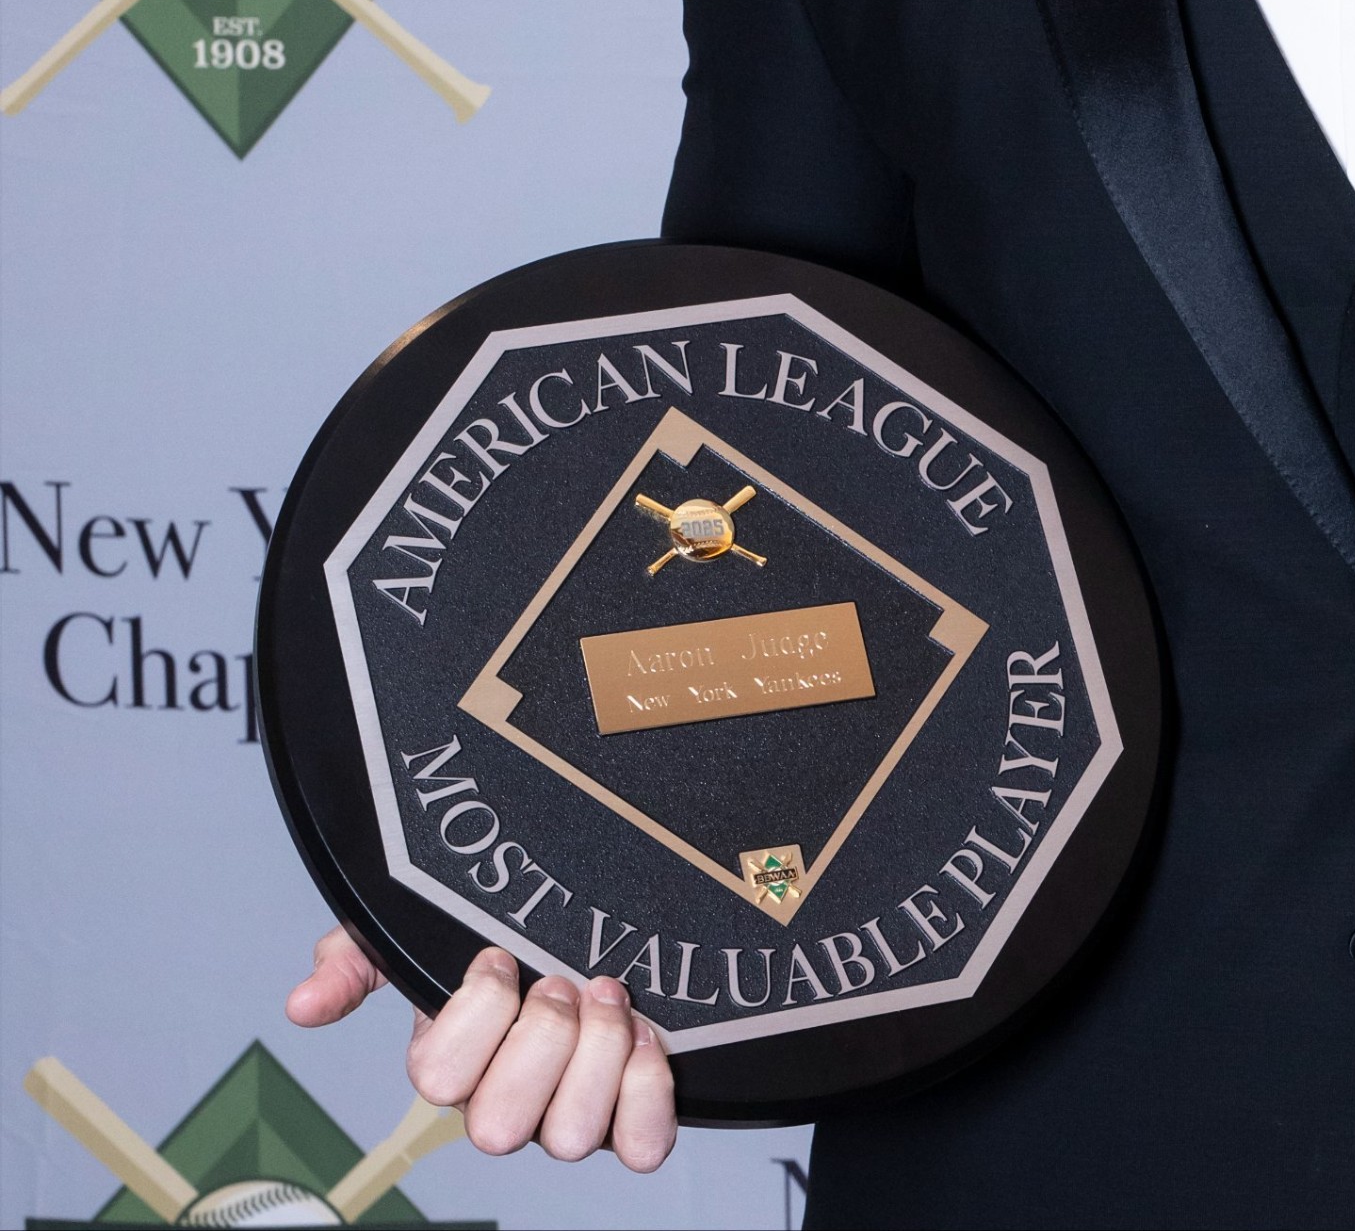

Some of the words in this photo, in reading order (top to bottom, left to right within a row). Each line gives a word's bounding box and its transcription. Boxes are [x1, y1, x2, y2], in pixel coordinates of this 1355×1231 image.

[212, 17, 263, 36] EST.
[193, 40, 286, 70] 1908
[371, 339, 693, 627] AMERICAN
[717, 343, 1014, 537] LEAGUE
[0, 481, 212, 581] New
[680, 518, 725, 538] 2025
[626, 648, 716, 677] Aaron
[400, 734, 574, 930] MOST
[580, 882, 966, 1008] VALUABLE
[952, 641, 1067, 916] PLAYER
